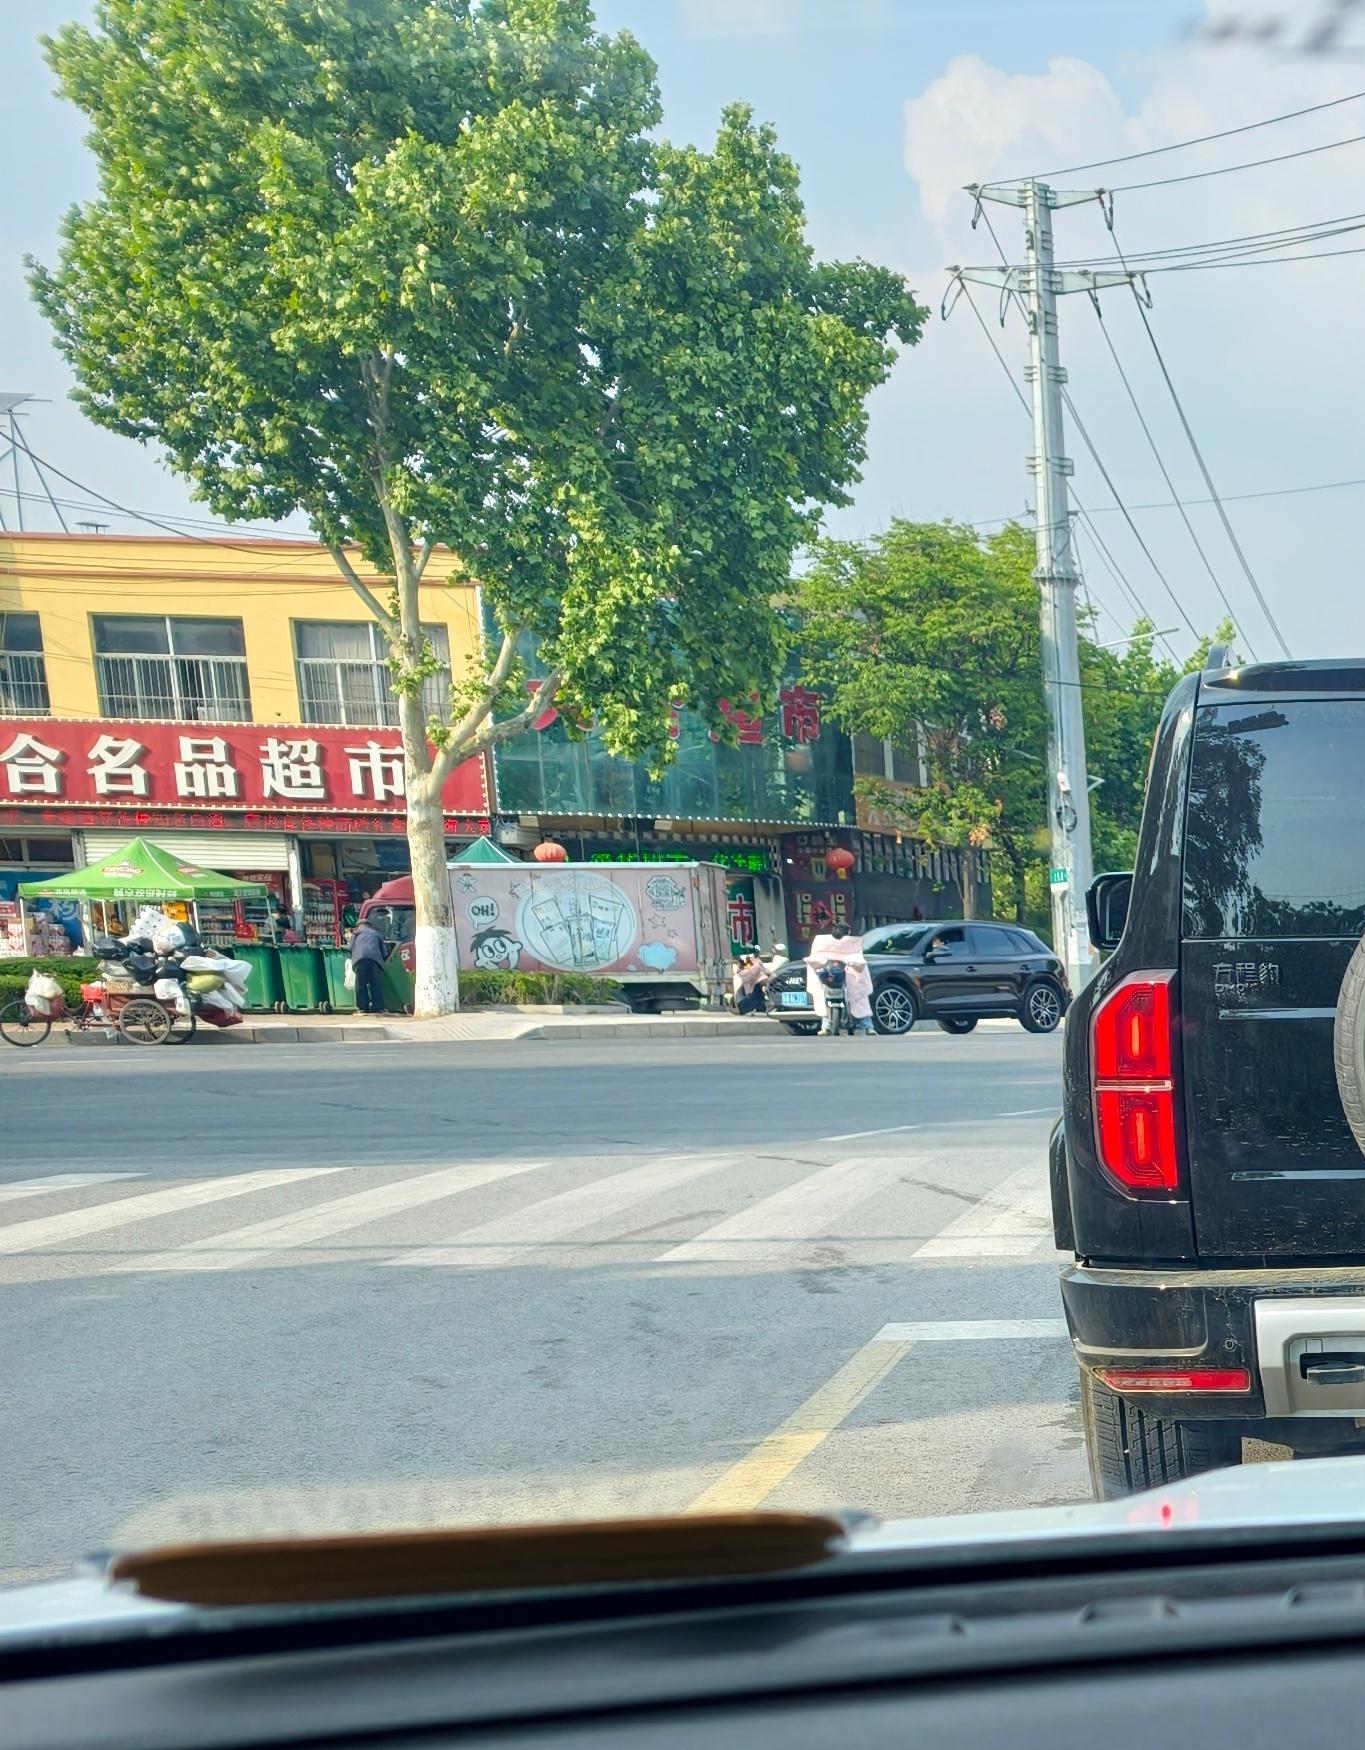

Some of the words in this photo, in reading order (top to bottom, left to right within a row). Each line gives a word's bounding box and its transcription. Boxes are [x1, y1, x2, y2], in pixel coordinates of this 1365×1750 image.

[0, 733, 406, 801] 合名品超市
[471, 903, 495, 917] OH!
[1212, 962, 1280, 985] 方程豹
